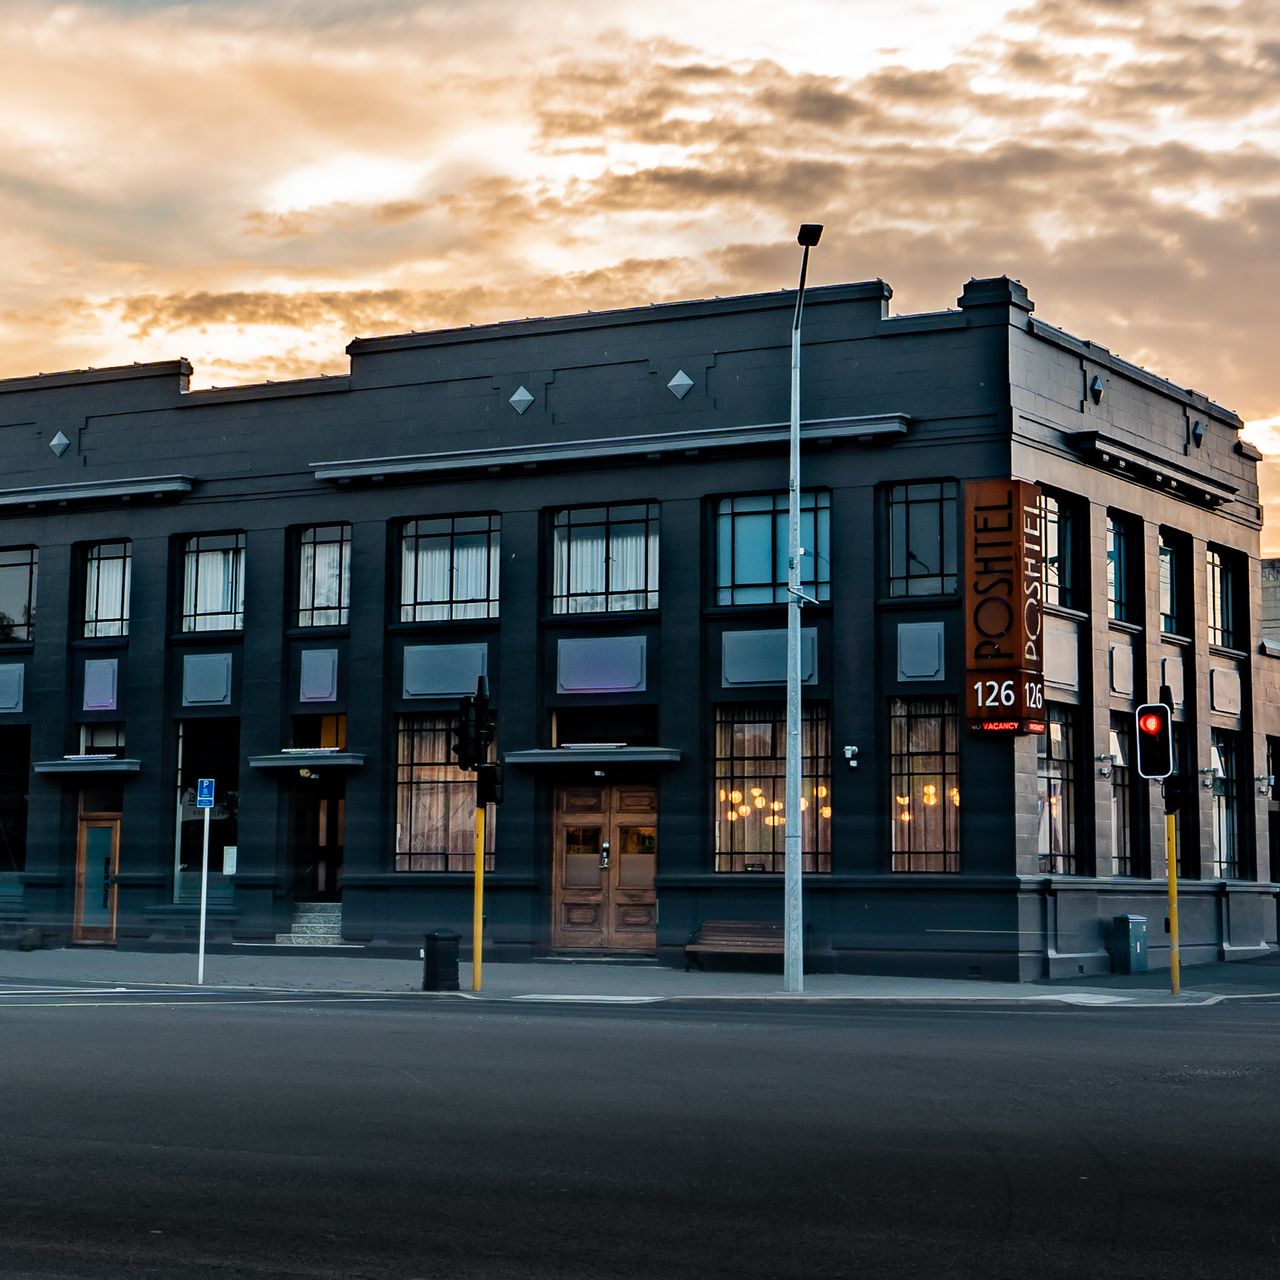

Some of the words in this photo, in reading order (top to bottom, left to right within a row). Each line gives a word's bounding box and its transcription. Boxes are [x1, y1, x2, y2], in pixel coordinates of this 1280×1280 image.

[973, 490, 1014, 660] POSHTEL
[1023, 496, 1041, 662] POSHTEL
[973, 680, 1015, 707] 126
[1024, 682, 1043, 709] 126
[983, 722, 1019, 730] VACANCY
